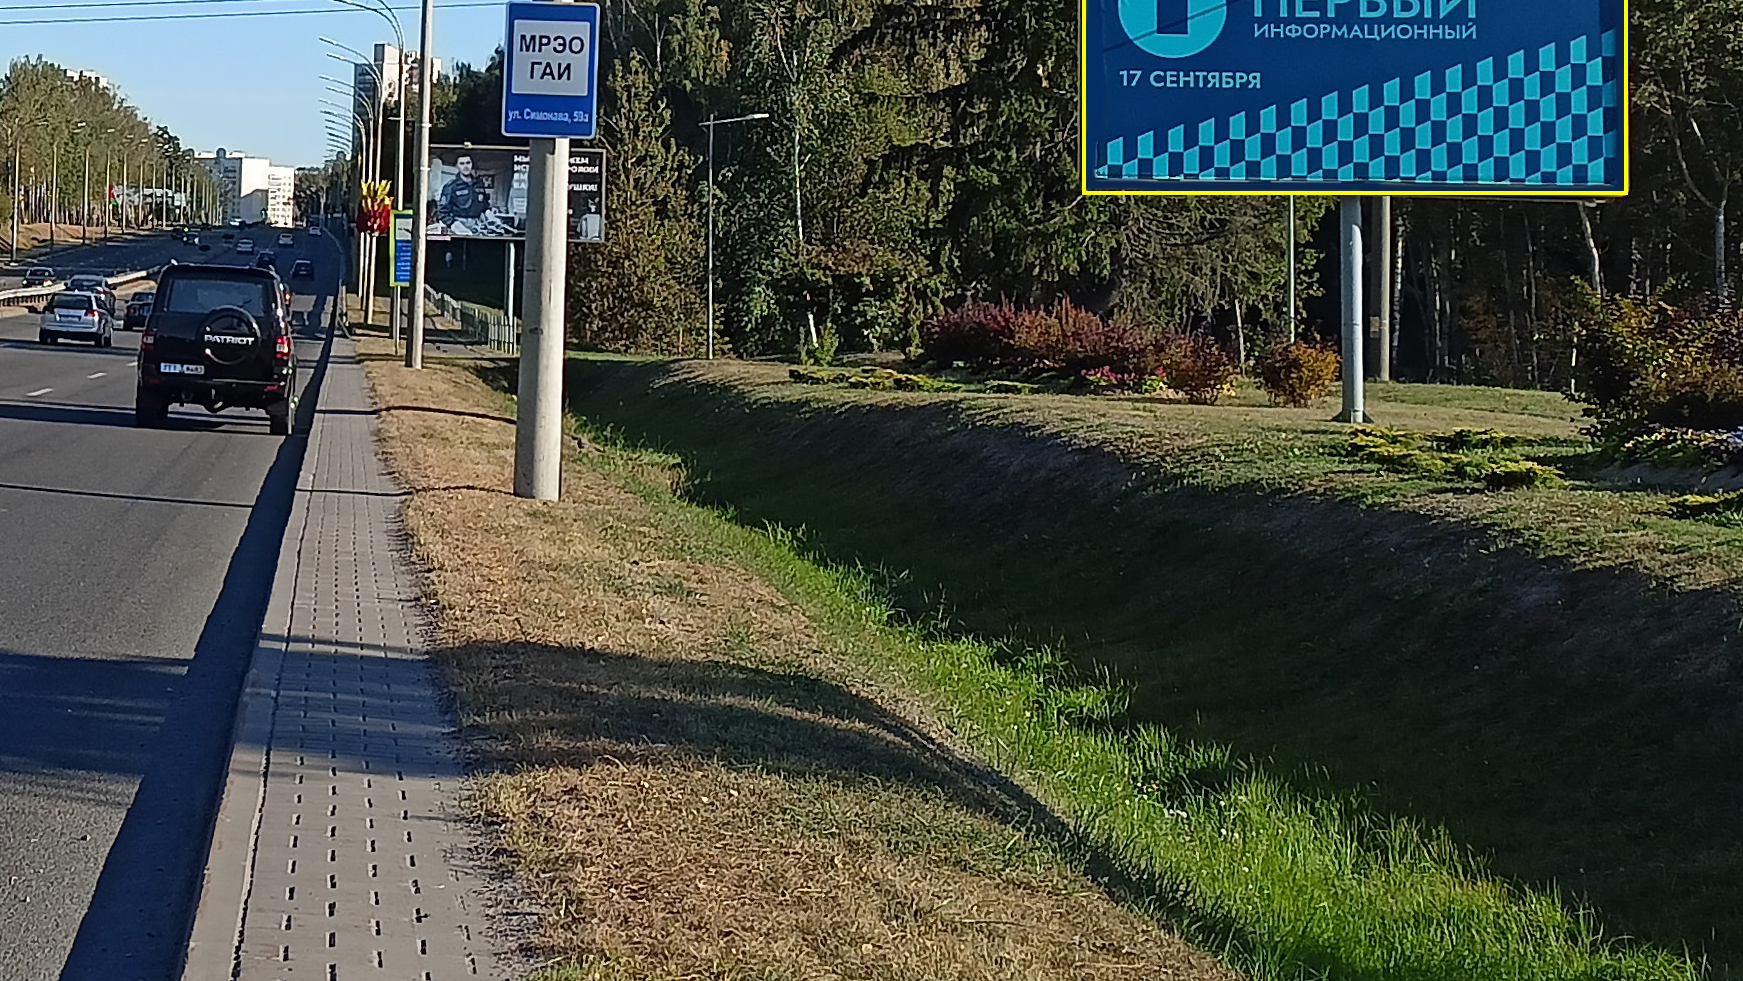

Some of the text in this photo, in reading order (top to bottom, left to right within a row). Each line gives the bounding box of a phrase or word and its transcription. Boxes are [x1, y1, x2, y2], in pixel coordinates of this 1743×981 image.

[1253, 21, 1477, 41] ИНФОРМАЦИОННЫЙ
[519, 34, 585, 55] МРЭО
[530, 61, 572, 81] ГАИ
[1119, 70, 1262, 90] 17 СЕНТЯБРЯ
[204, 335, 255, 345] PATRIOT
